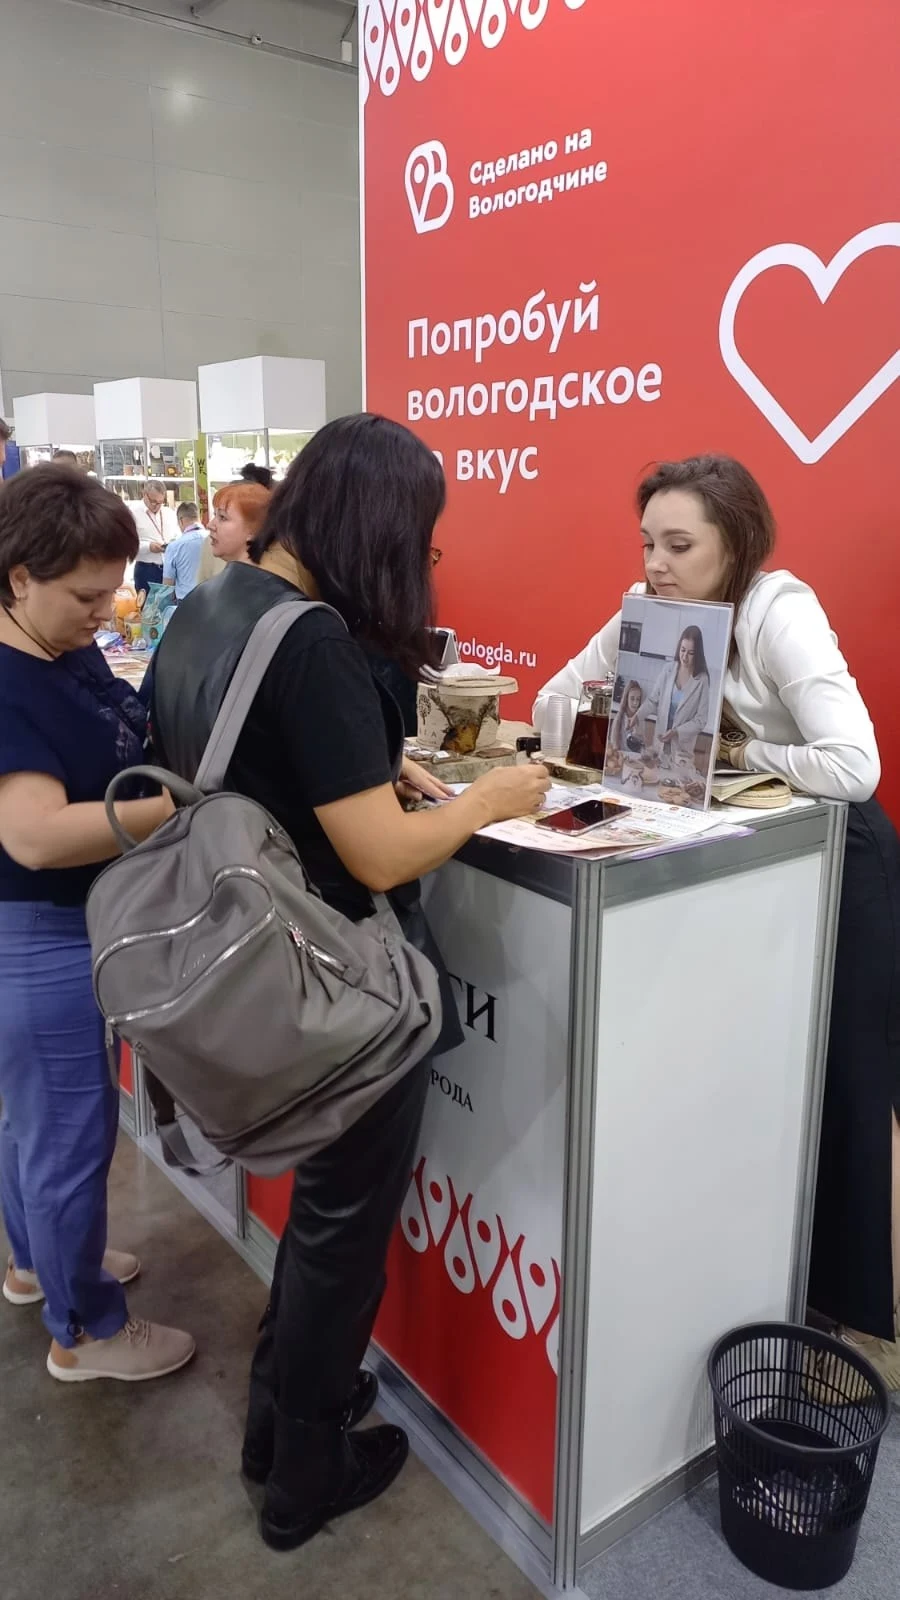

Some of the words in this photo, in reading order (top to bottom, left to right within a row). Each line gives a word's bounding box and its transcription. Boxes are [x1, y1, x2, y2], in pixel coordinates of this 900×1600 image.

[469, 140, 558, 186] Сделано
[564, 127, 592, 154] на
[468, 160, 608, 219] Вологодчине
[408, 279, 599, 363] Попробуй
[407, 362, 663, 421] вологодское
[456, 446, 539, 494] вкус
